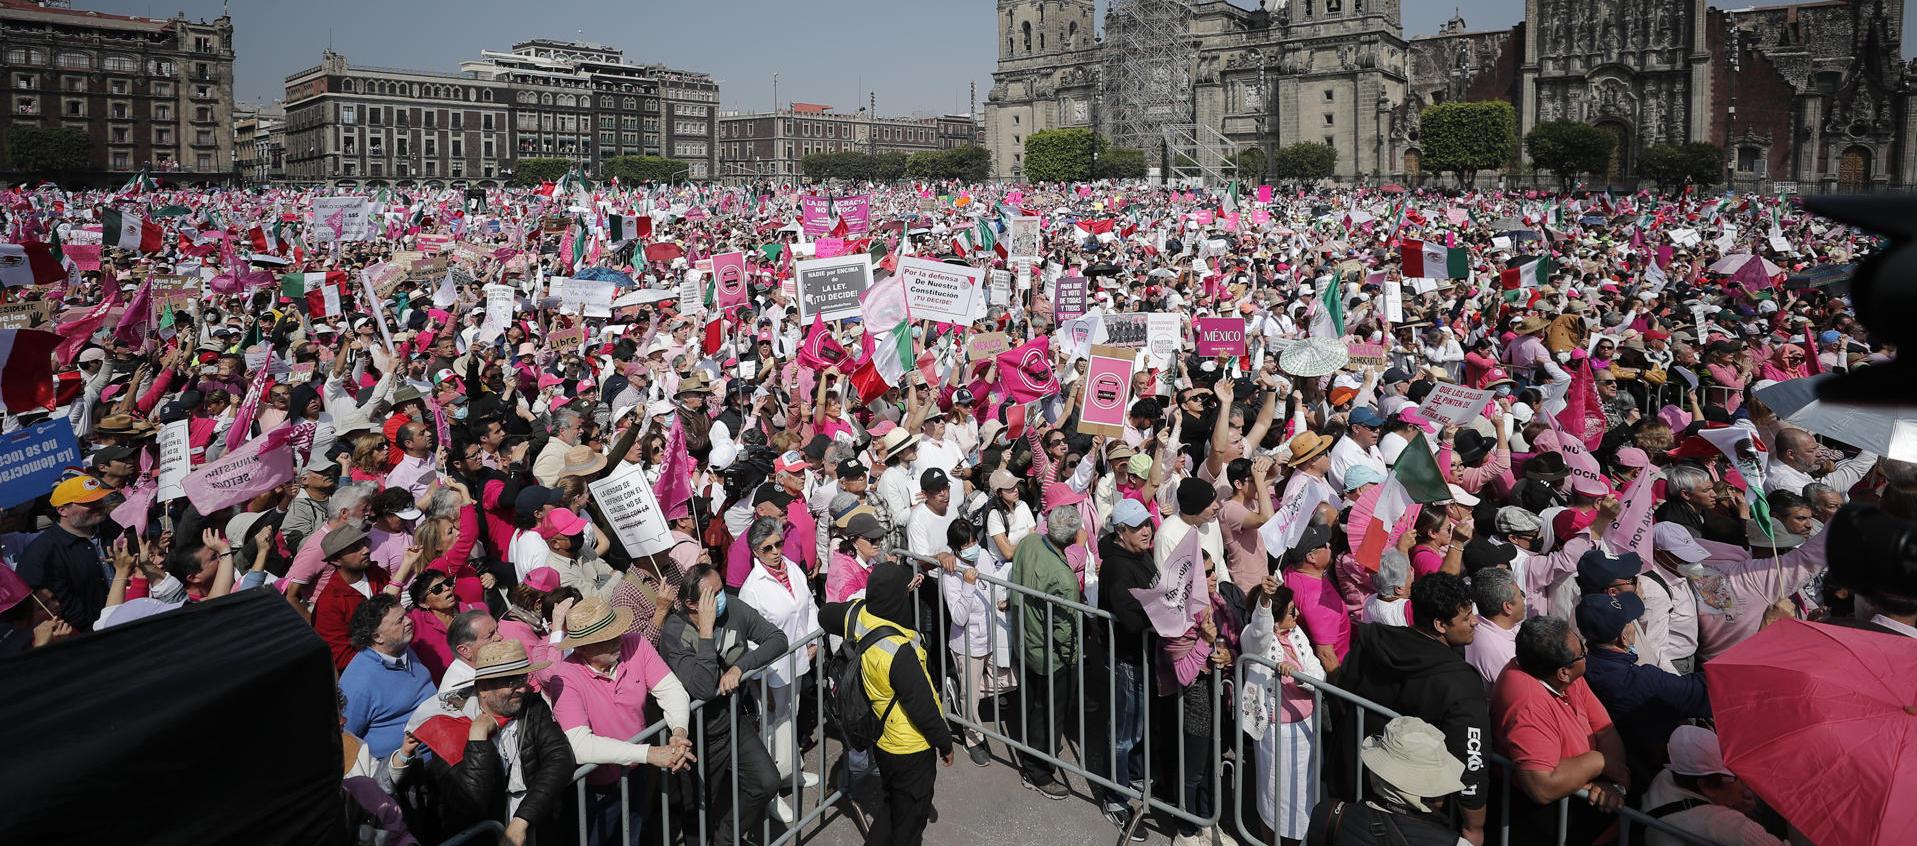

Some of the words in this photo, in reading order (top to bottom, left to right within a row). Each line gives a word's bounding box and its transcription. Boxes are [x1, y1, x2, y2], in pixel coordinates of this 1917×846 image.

[817, 199, 867, 207] DEOCRACIA
[807, 270, 826, 278] NADIE
[836, 266, 859, 274] ENCIMA
[928, 272, 959, 283] defensa
[927, 280, 958, 291] Nuestra
[828, 290, 858, 300] DECIDE!
[1203, 328, 1241, 342] MÉXICO
[550, 336, 578, 350] Libre
[1439, 385, 1453, 395] QUE
[1452, 389, 1464, 398] LAS
[1463, 391, 1483, 401] CALLES
[1433, 393, 1442, 401] SE
[1442, 396, 1463, 407] PINTEN
[1421, 409, 1438, 419] OTRA
[1438, 415, 1451, 424] VEZ
[26, 441, 41, 453] se
[44, 438, 58, 451] no
[623, 481, 631, 489] SE
[623, 490, 636, 500] CON
[635, 486, 642, 494] EL
[626, 500, 634, 509] NO
[634, 497, 642, 505] SE
